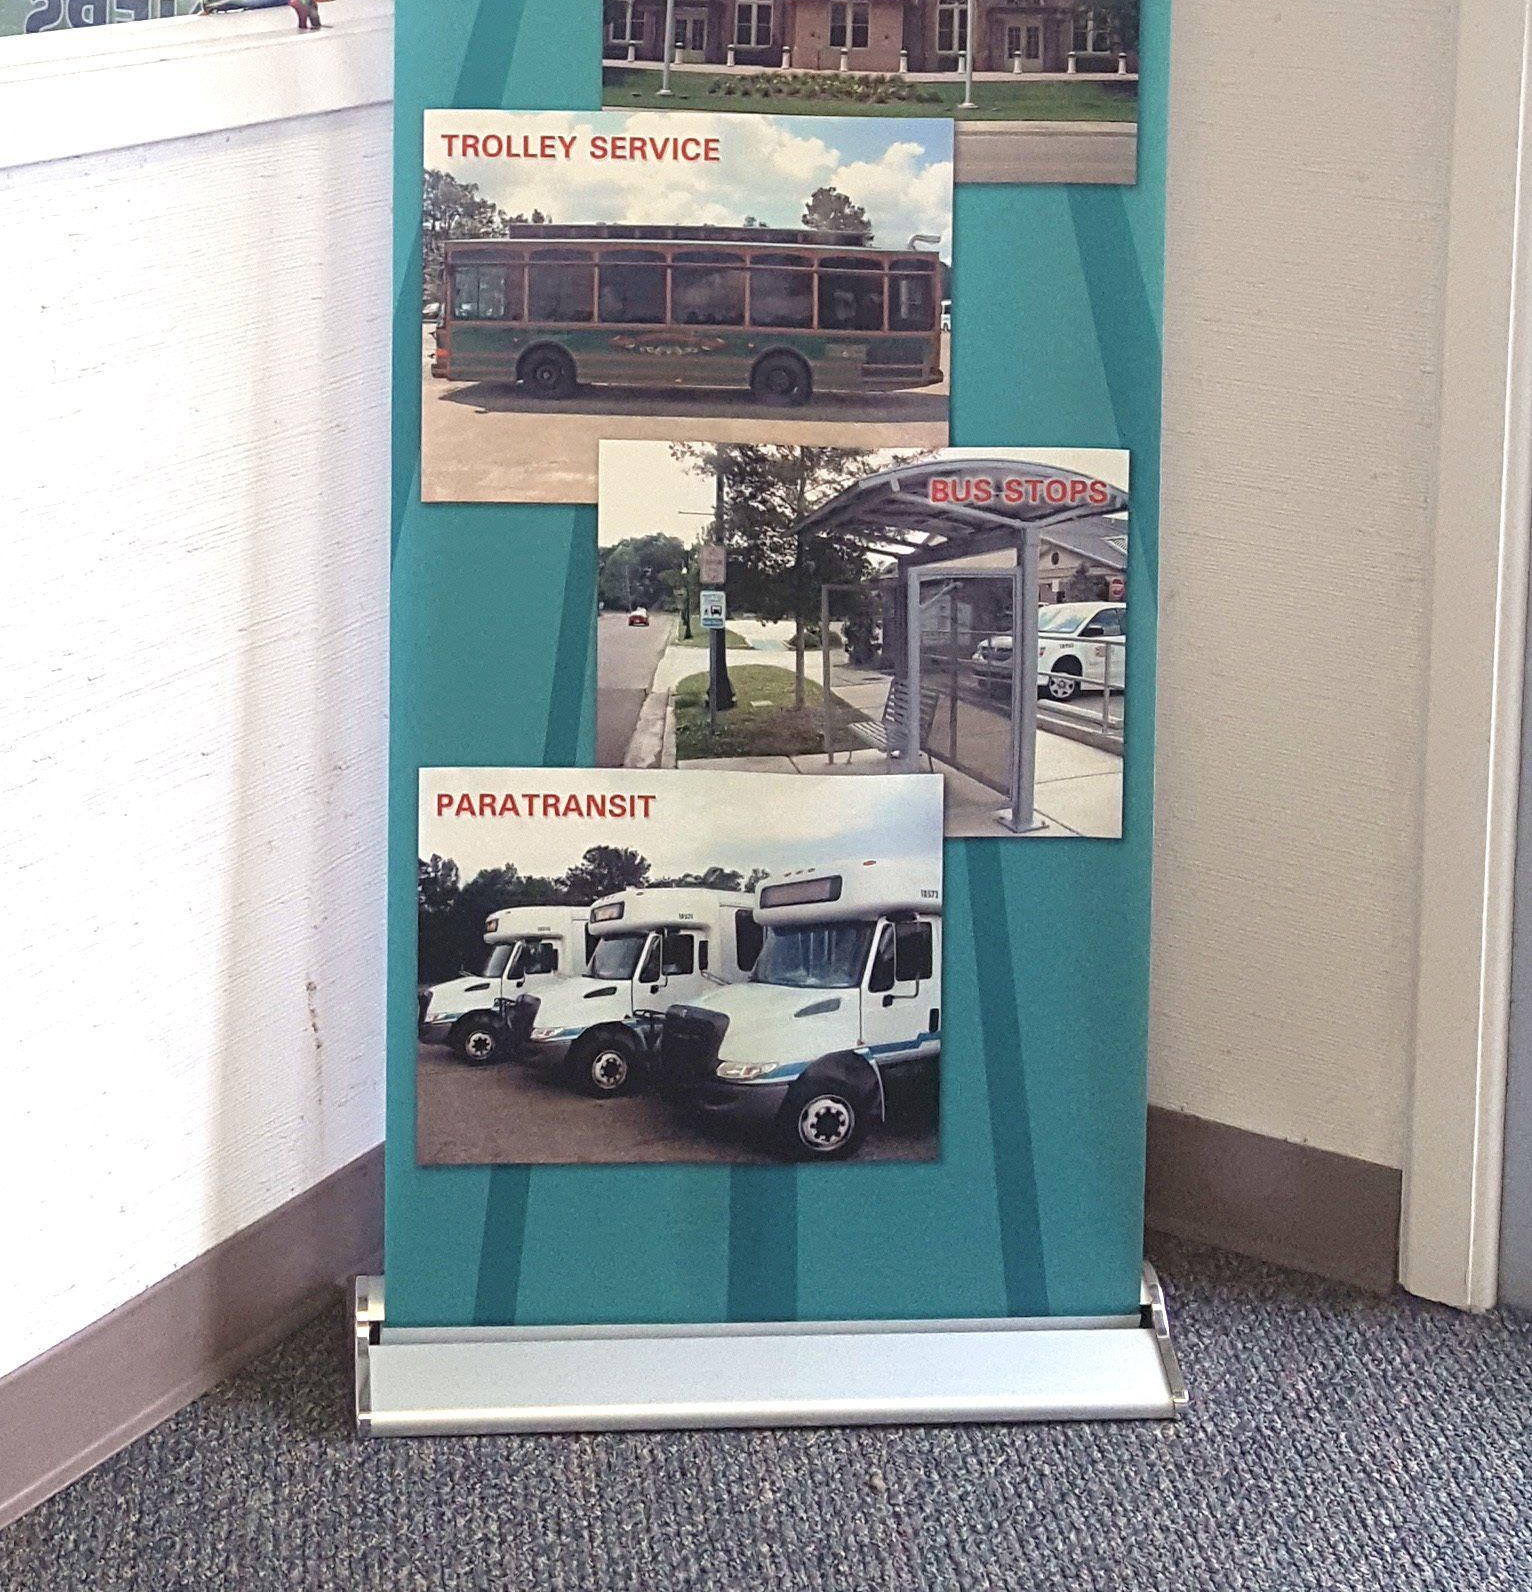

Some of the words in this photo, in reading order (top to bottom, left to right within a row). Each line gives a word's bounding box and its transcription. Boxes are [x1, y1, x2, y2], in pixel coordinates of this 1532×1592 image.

[441, 134, 577, 159] TROLLEY
[590, 136, 720, 161] SERVICE
[930, 479, 992, 503] BUS
[1005, 479, 1109, 504] STOPS
[437, 793, 656, 819] PARATRANSIT
